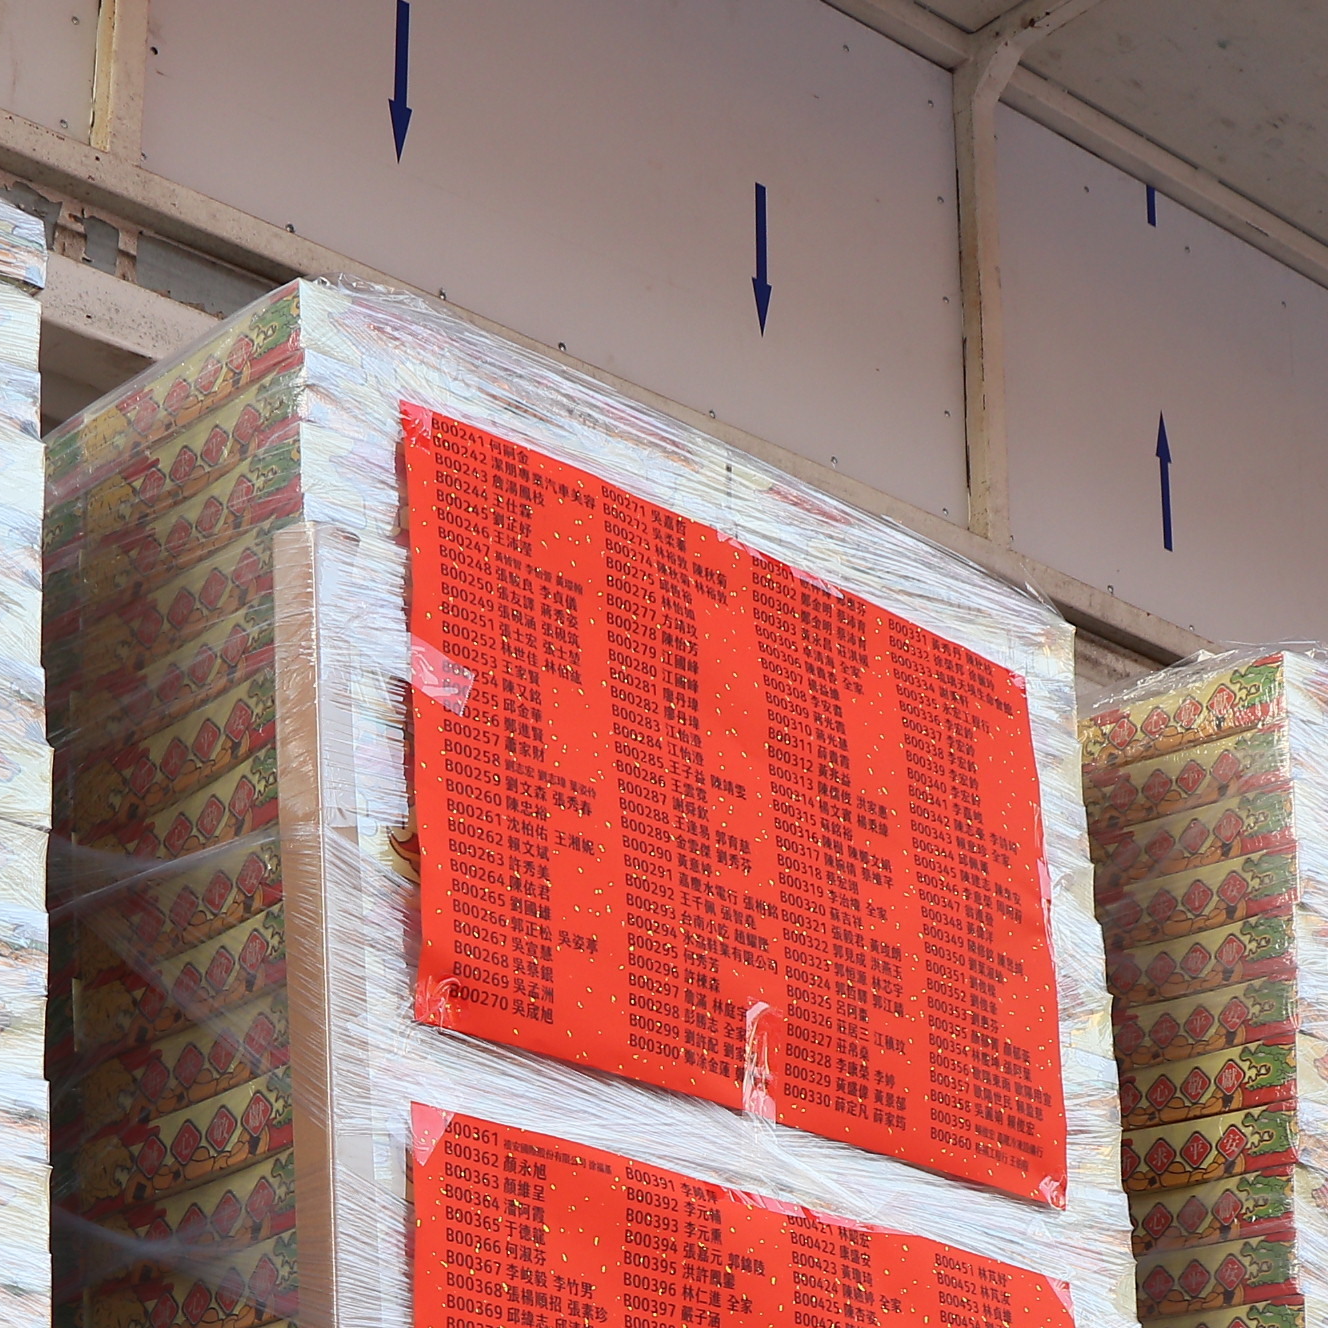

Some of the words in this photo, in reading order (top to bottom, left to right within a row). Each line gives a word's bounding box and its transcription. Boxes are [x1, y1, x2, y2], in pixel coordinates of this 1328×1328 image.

[443, 641, 497, 667] B00253
[896, 684, 938, 710] B00335
[614, 741, 664, 769] B00285
[445, 758, 501, 786] B00259
[447, 817, 503, 846] B00262
[780, 890, 826, 916] B00320
[623, 1272, 676, 1297] B00396
